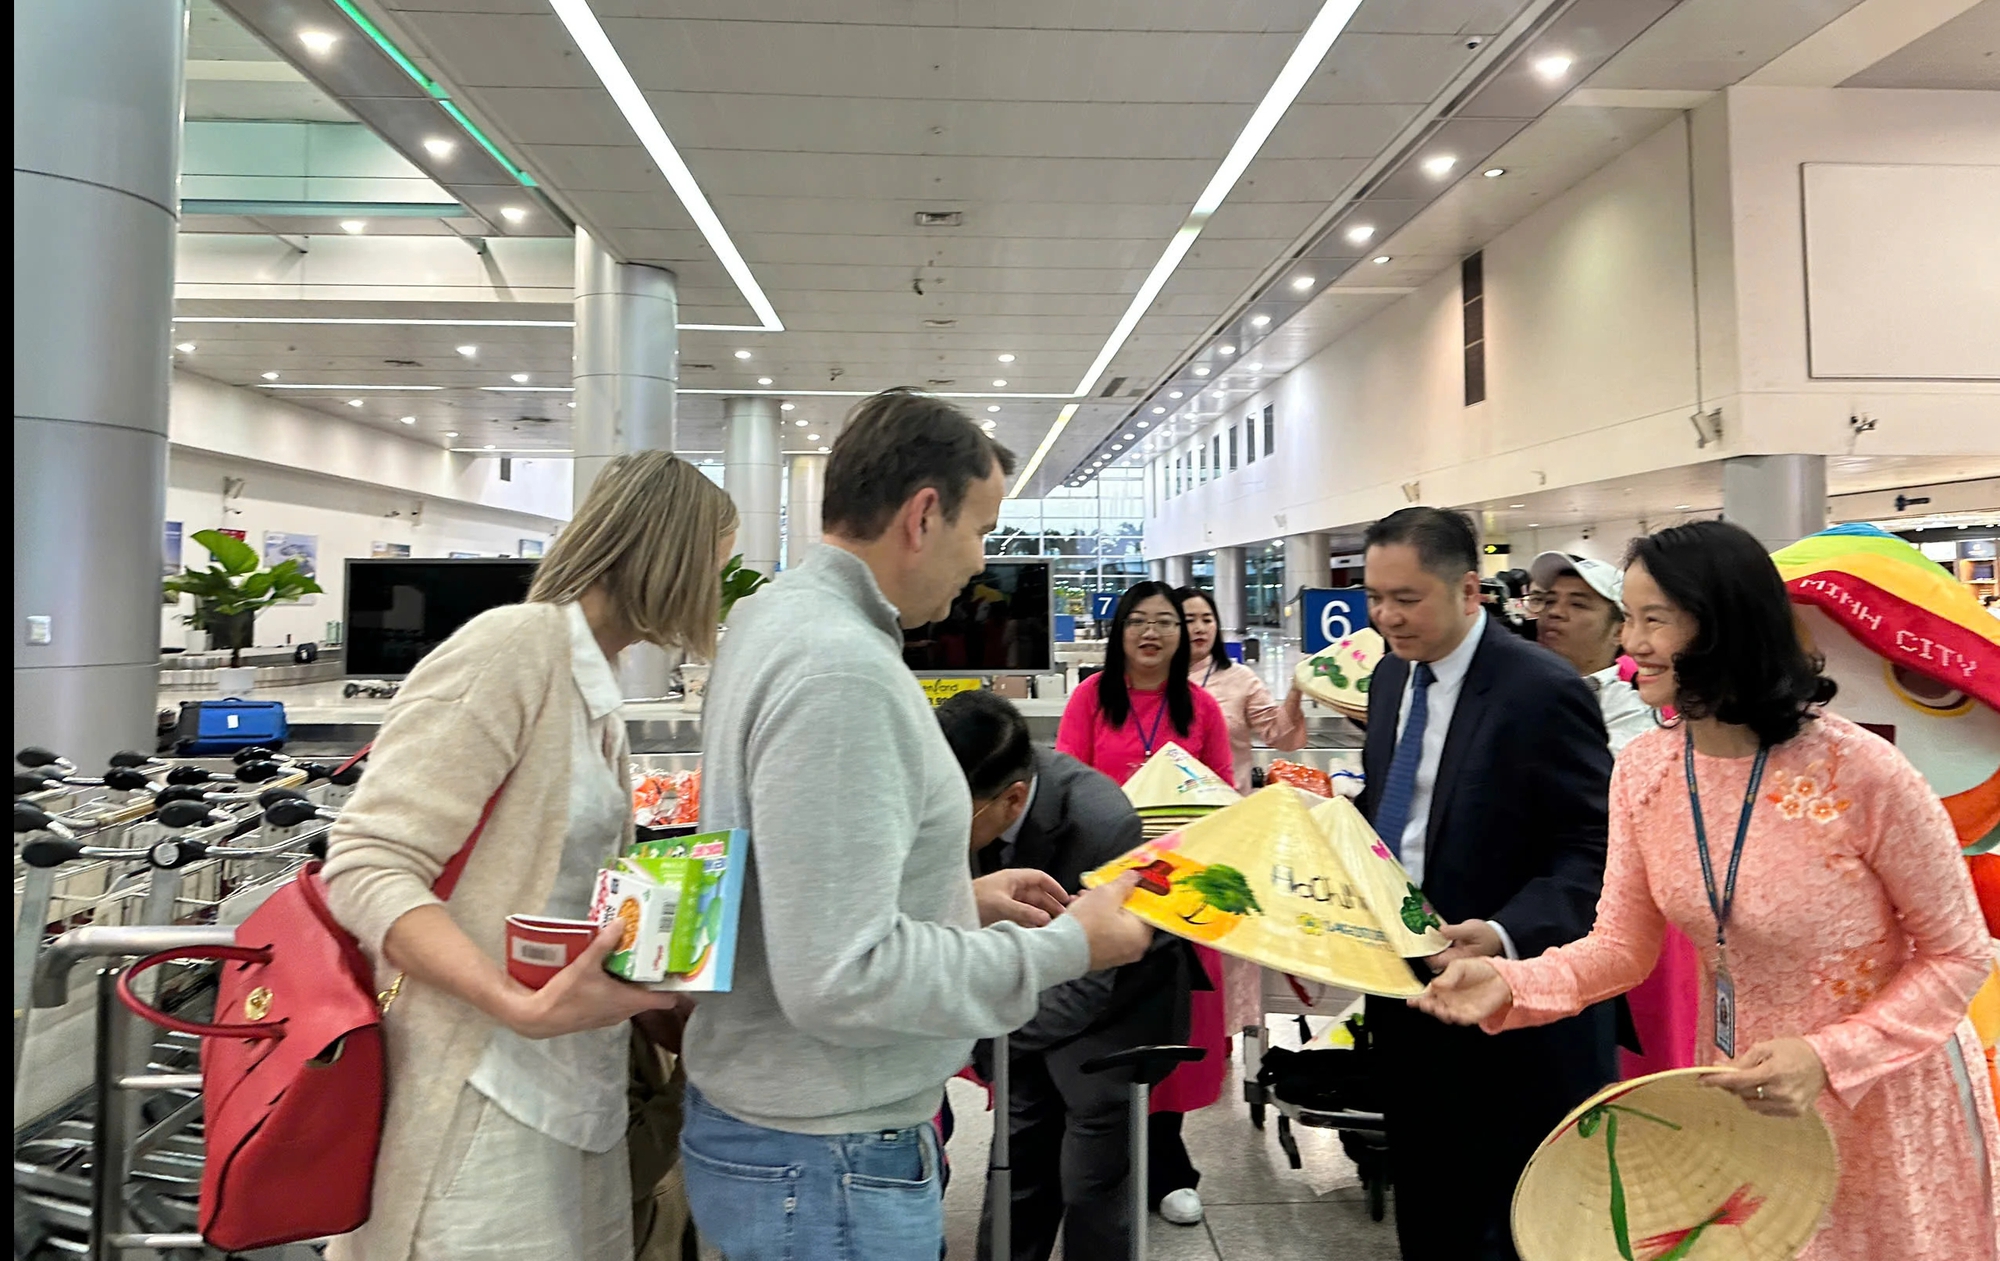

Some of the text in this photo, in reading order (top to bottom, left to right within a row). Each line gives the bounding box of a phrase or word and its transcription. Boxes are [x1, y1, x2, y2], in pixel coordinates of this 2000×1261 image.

[1098, 596, 1113, 616] 7
[1320, 599, 1353, 644] 6
[1799, 578, 1979, 678] MINH CITY
